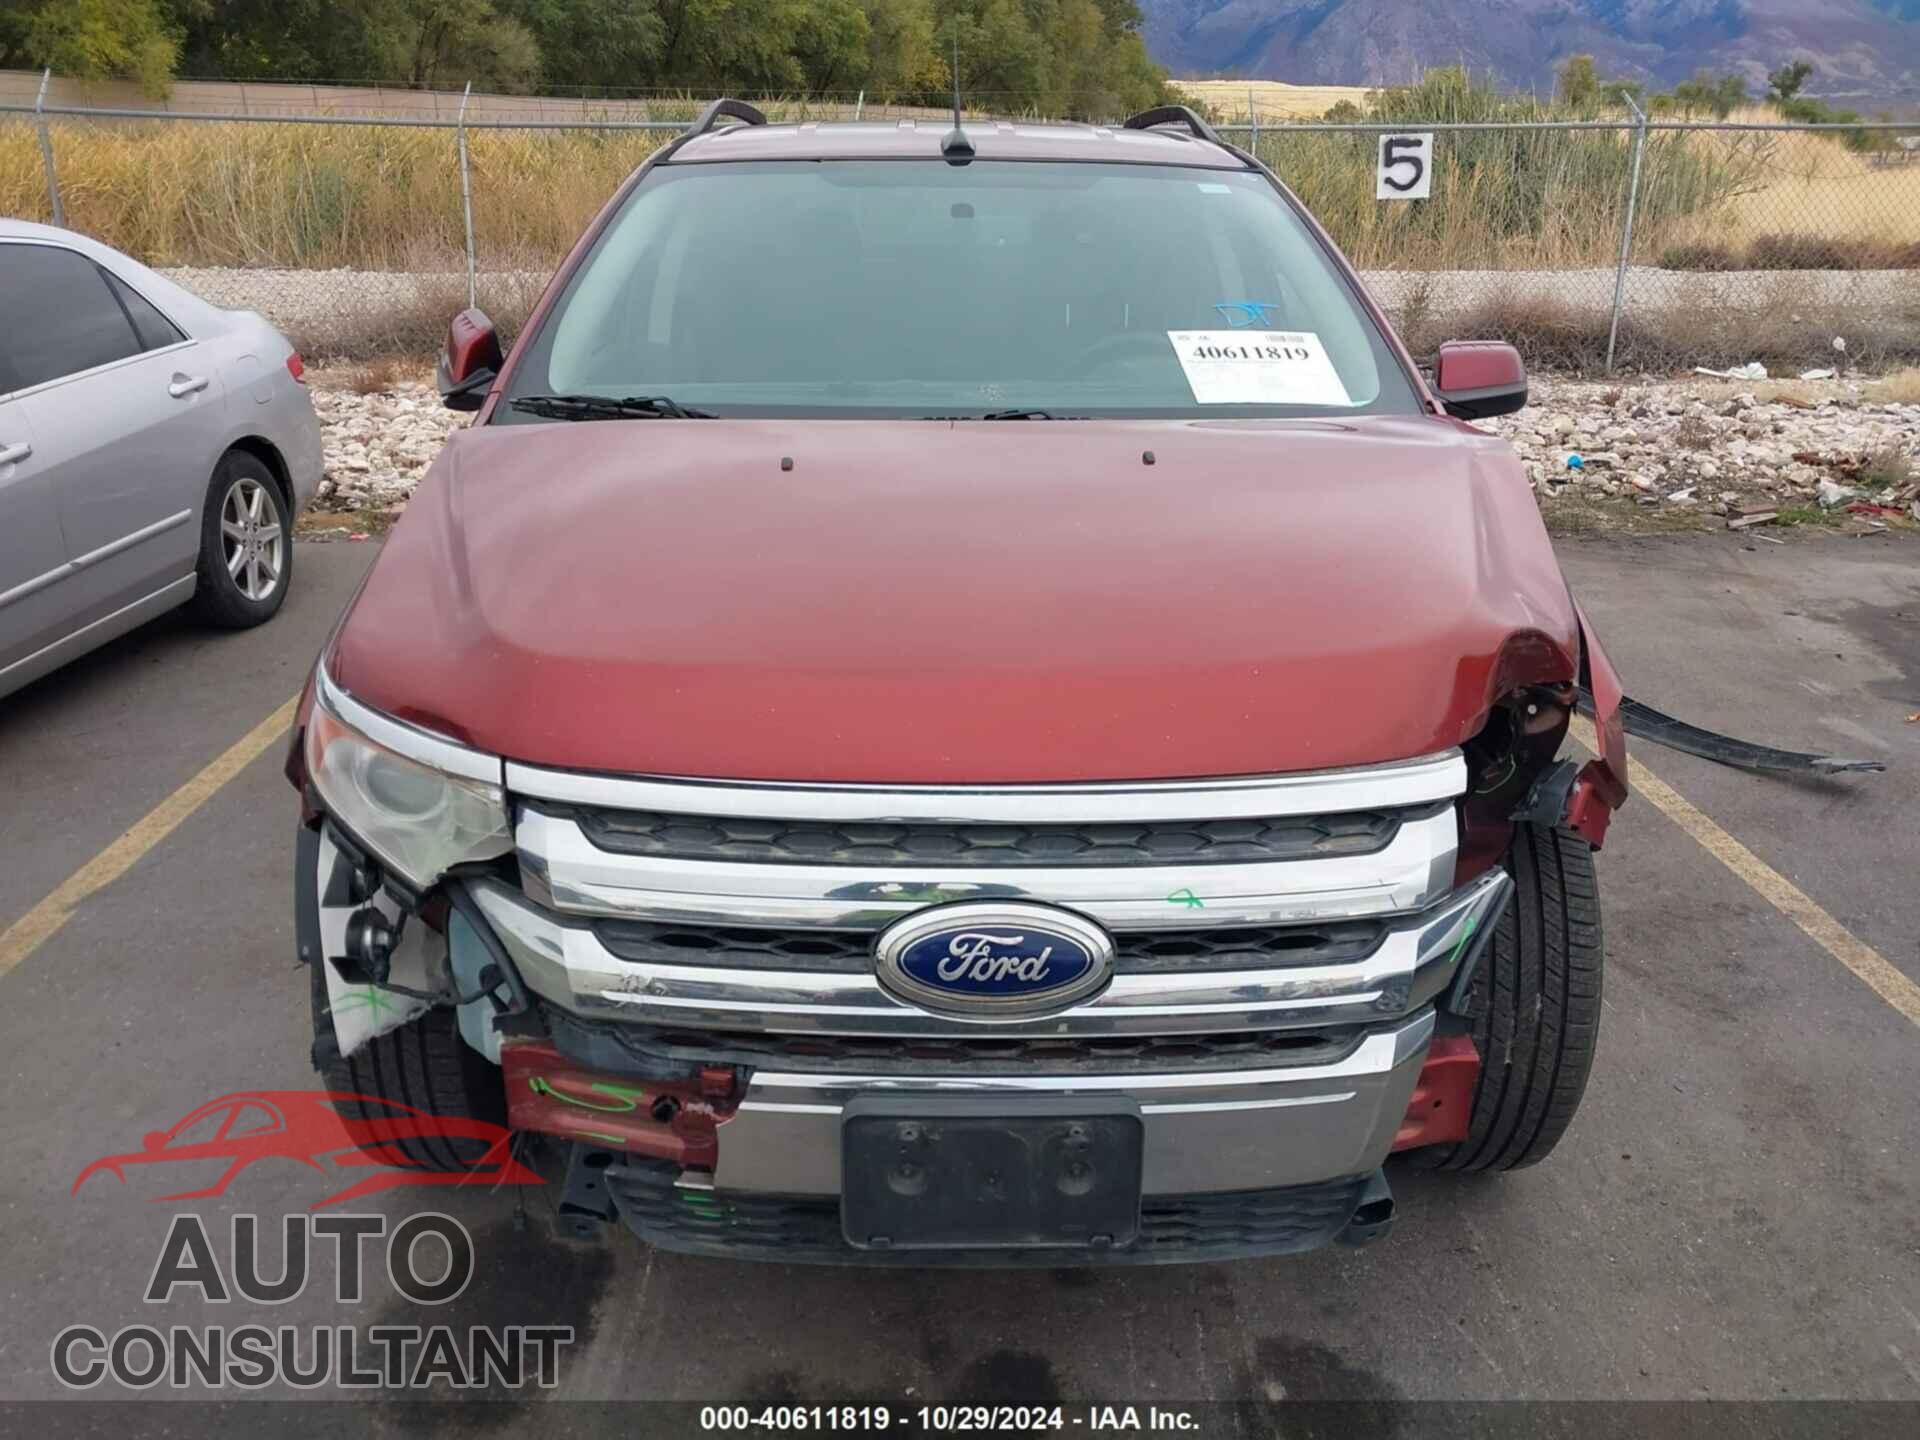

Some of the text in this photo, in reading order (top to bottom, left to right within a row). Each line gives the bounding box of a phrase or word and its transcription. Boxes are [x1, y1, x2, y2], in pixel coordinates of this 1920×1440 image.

[1384, 138, 1424, 191] 5
[1193, 345, 1309, 361] 40611819
[937, 932, 1053, 982] Ford
